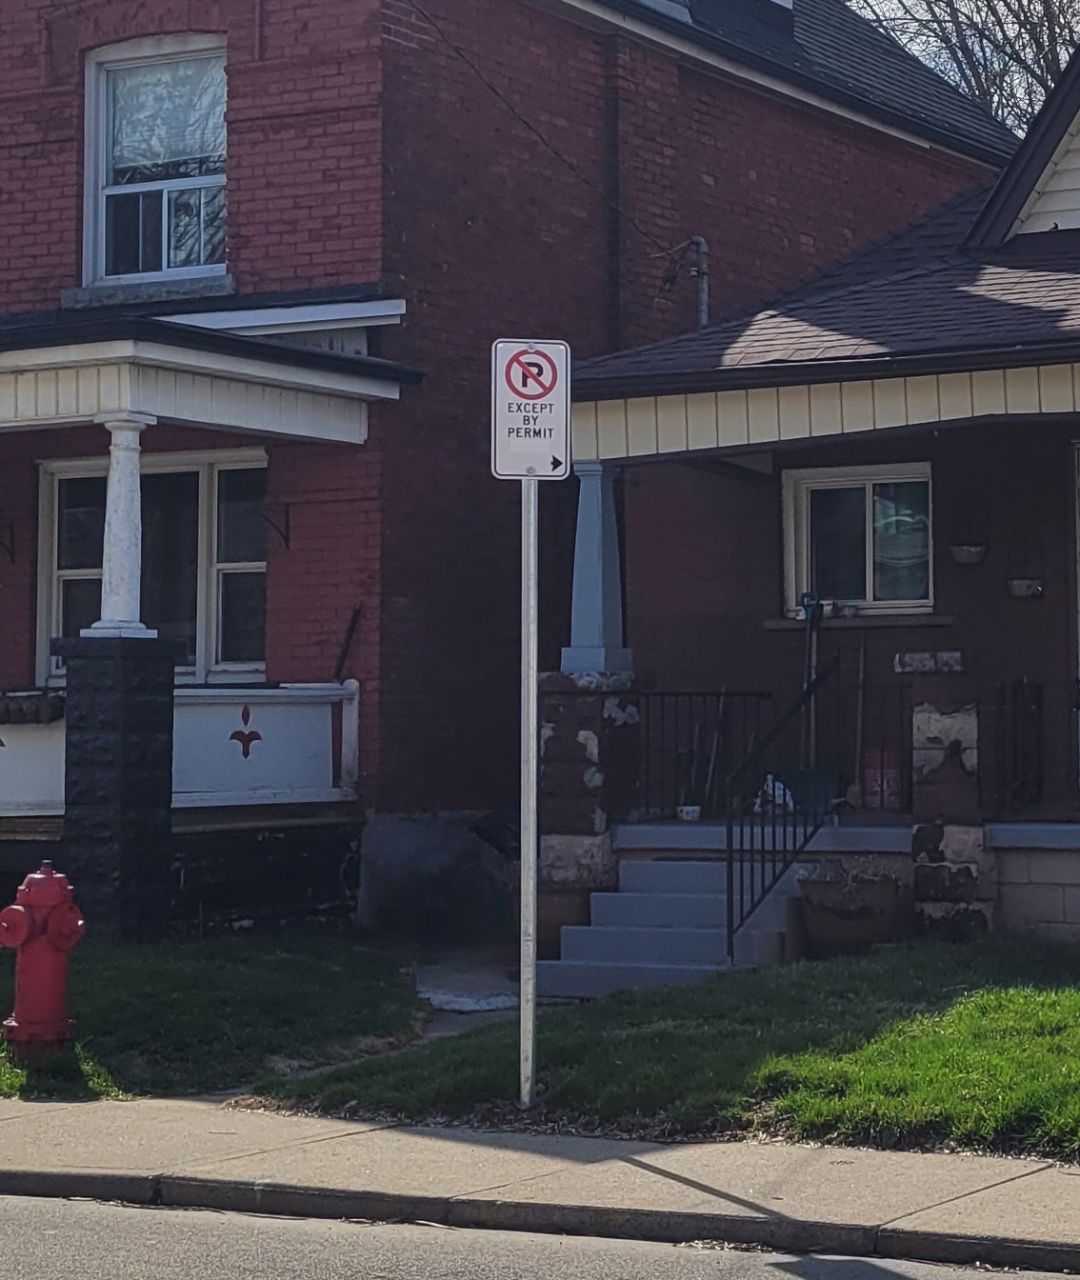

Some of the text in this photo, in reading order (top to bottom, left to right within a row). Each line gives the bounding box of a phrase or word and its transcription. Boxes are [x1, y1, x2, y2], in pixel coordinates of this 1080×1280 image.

[507, 402, 555, 414] EXCEPT
[523, 415, 539, 426] BY
[507, 427, 554, 439] PERMIT
